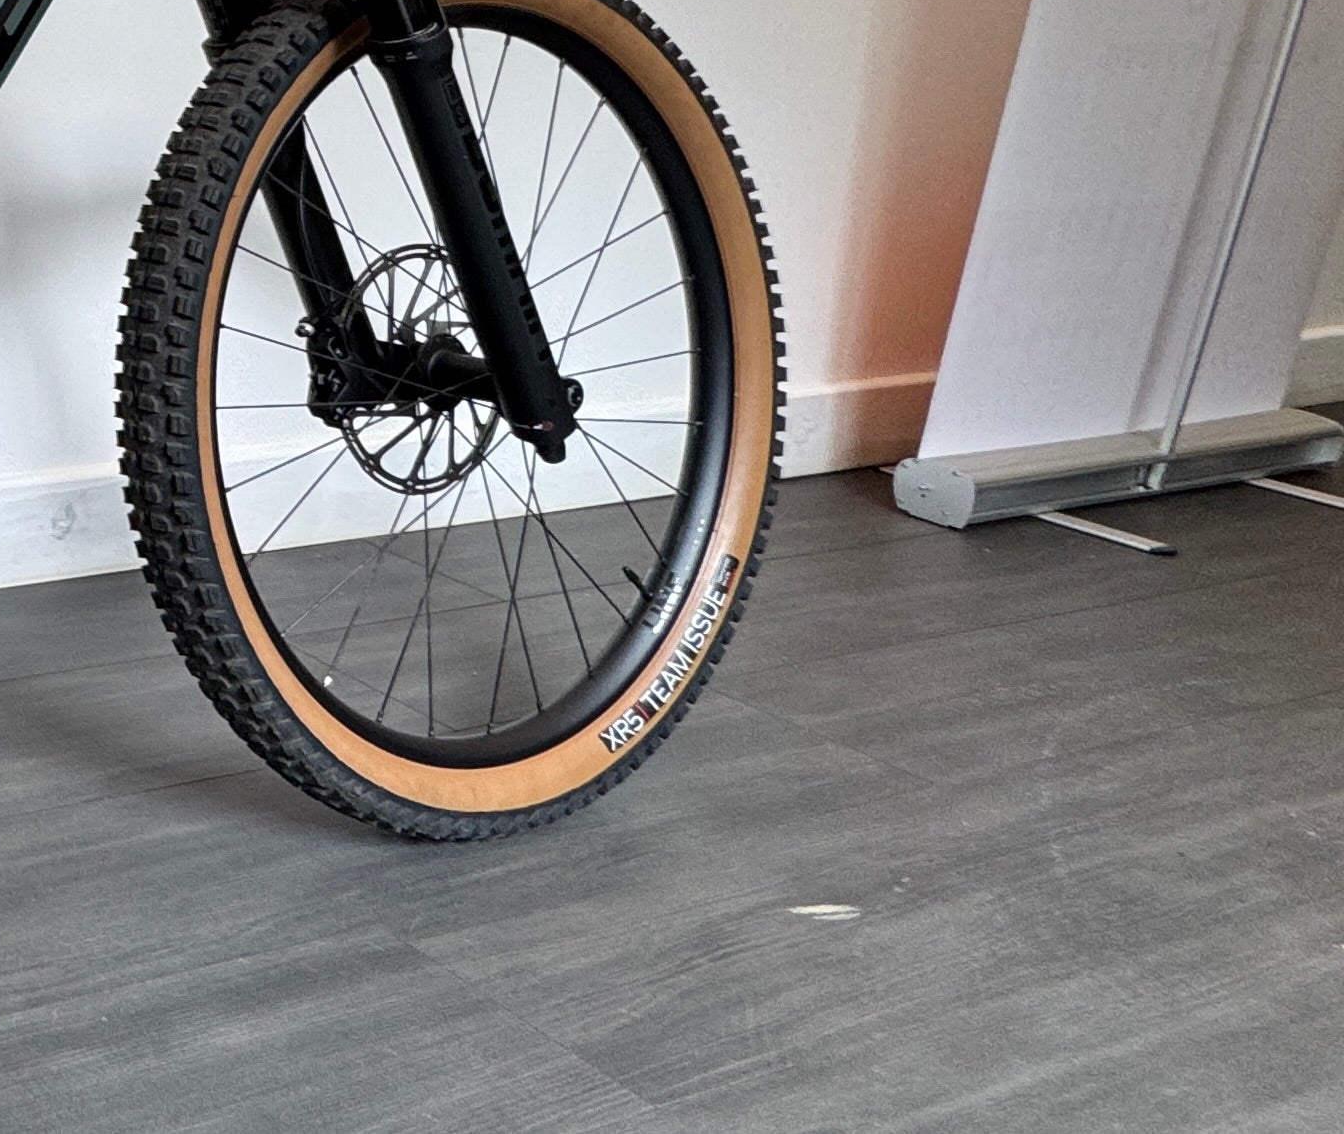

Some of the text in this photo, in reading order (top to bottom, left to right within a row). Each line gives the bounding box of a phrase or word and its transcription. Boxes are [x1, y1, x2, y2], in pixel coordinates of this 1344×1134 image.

[600, 707, 646, 752] XR5
[639, 653, 694, 713] TEAM
[680, 583, 728, 655] ISSUE
